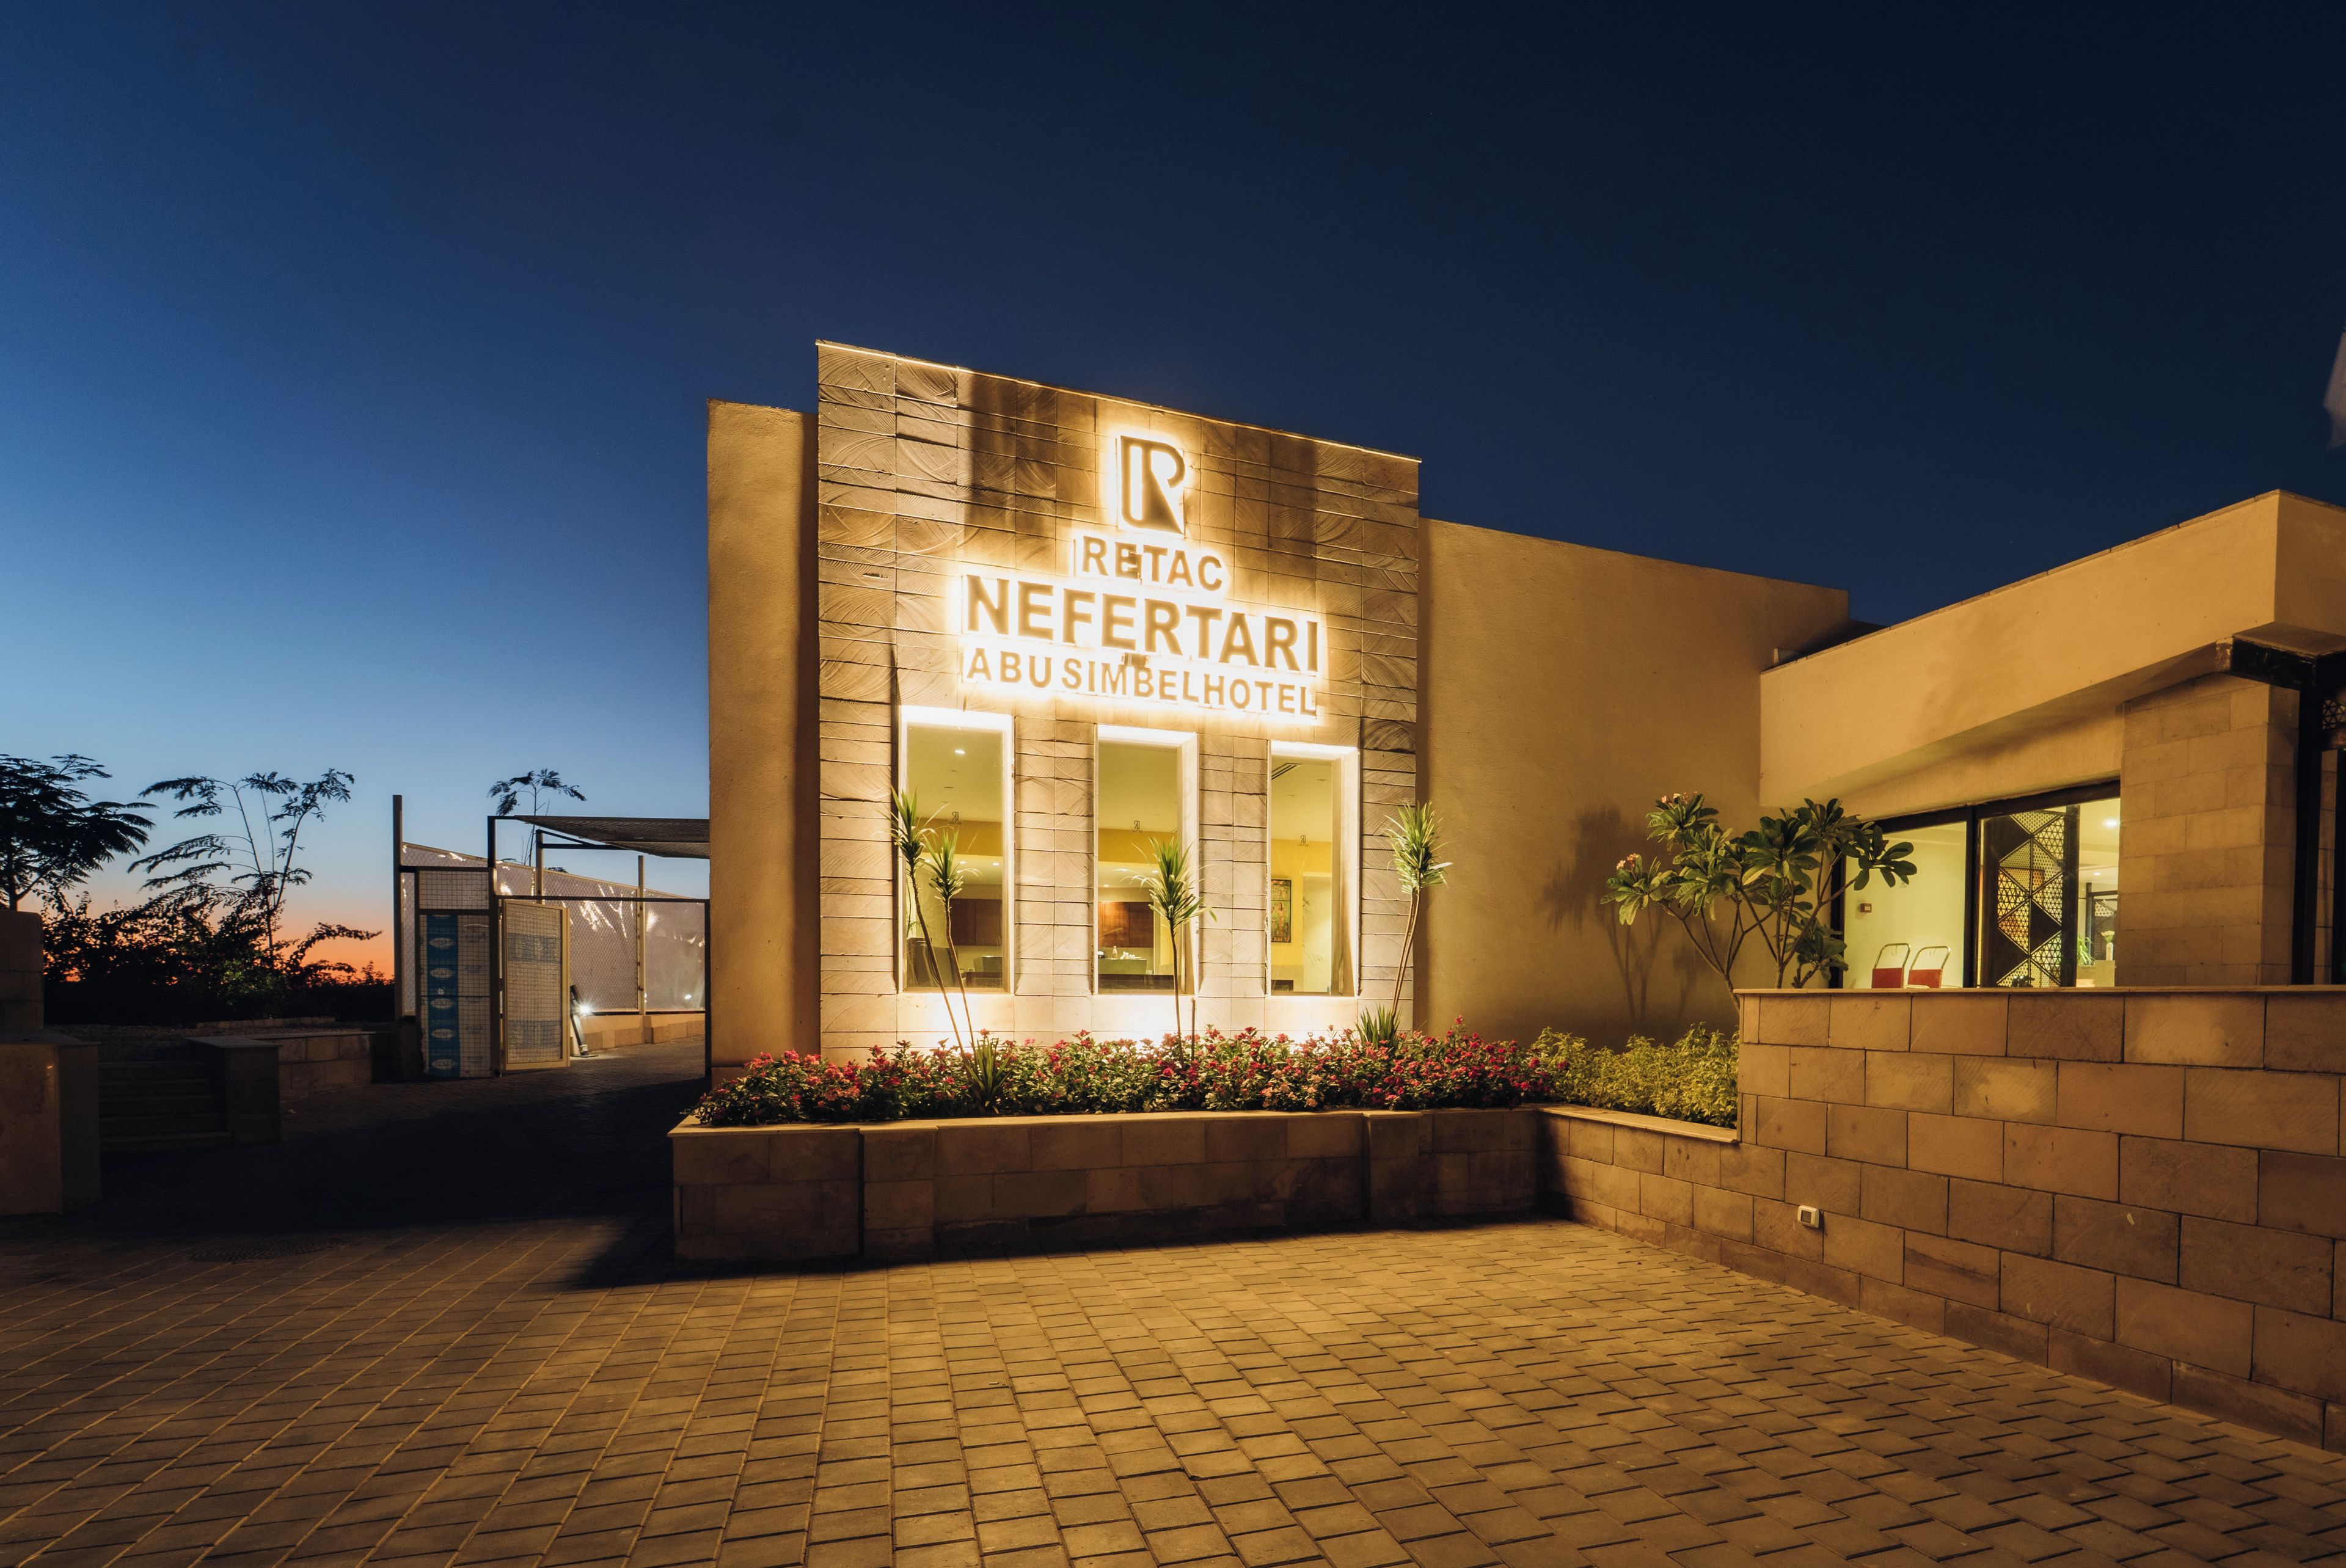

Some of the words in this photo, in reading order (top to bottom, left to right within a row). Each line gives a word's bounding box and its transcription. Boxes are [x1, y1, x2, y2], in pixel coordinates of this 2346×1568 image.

[1082, 535, 1222, 591] RETAC
[967, 574, 1318, 672] NEFERTARI
[967, 647, 1052, 688] ABU
